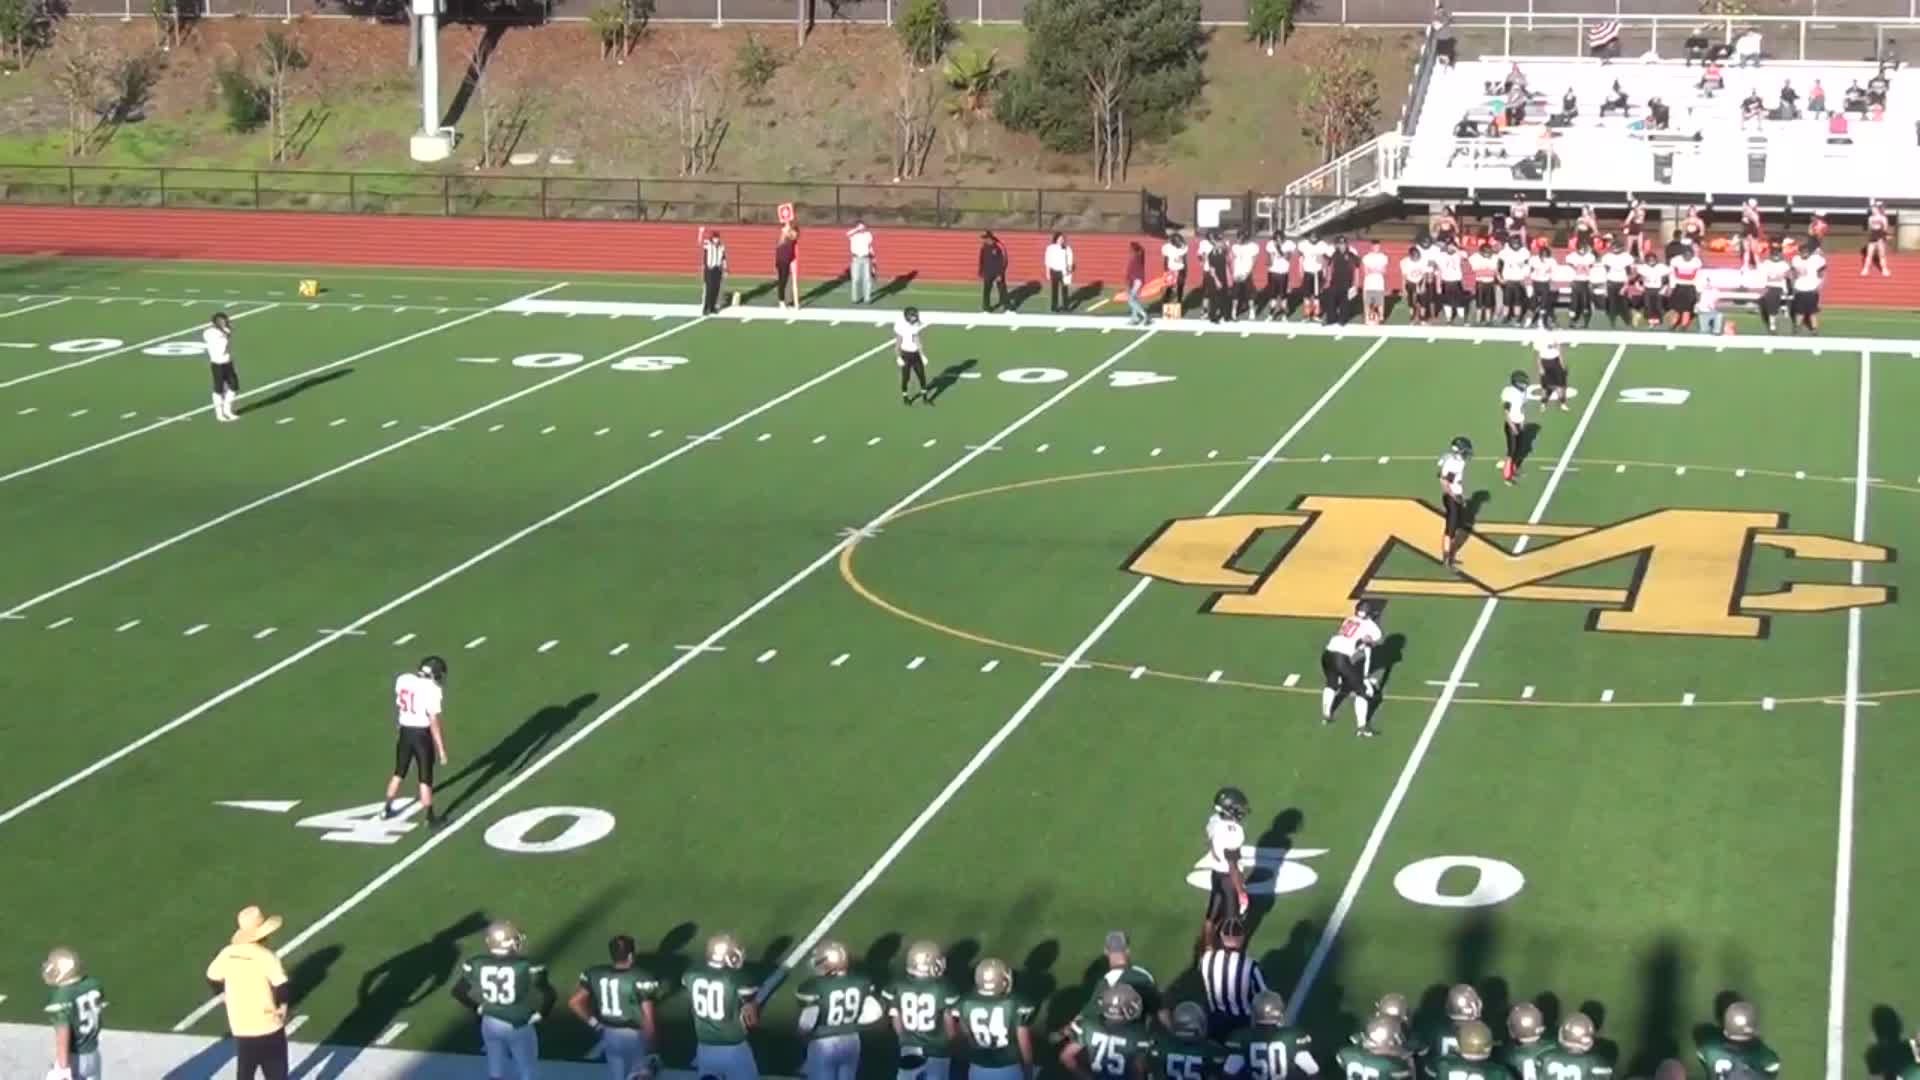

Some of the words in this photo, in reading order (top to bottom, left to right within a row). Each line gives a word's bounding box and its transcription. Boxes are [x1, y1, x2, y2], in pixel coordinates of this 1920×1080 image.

[480, 965, 516, 1005] 53
[600, 977, 622, 1016] 11
[692, 978, 725, 1020] 60
[827, 987, 861, 1026] 69
[900, 991, 936, 1032] 82
[970, 1006, 1009, 1048] 64
[1091, 1031, 1128, 1075] 75
[1167, 1053, 1203, 1080] 55
[1250, 1041, 1287, 1080] 50
